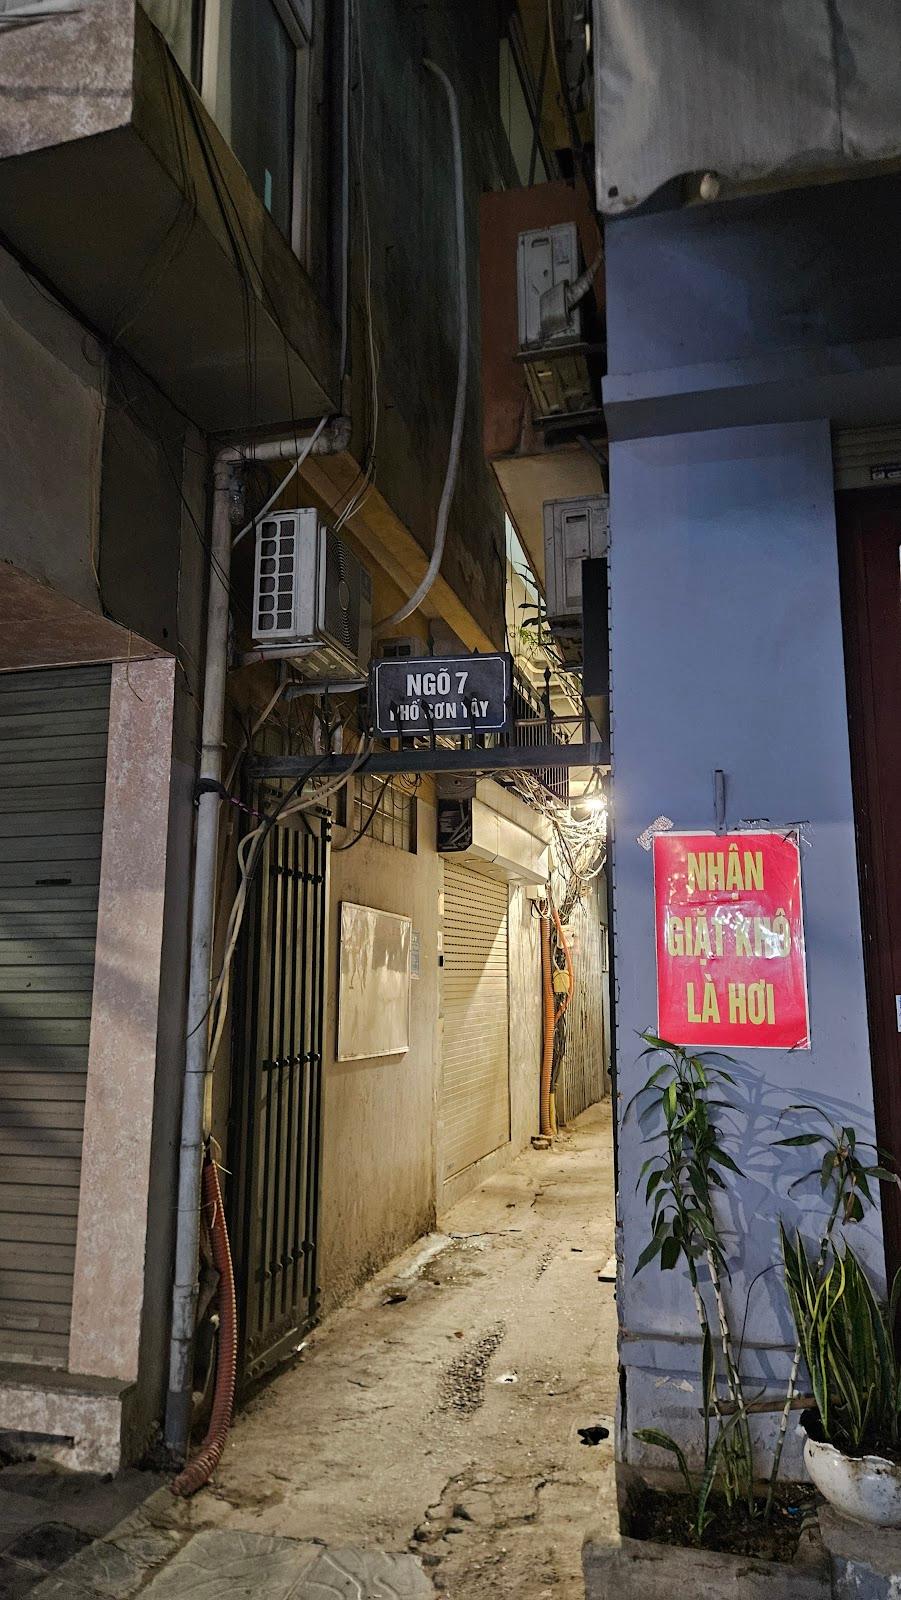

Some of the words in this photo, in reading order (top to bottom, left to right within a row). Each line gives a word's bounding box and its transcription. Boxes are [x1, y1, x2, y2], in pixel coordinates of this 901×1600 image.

[406, 667, 451, 697] NGÕ
[455, 671, 469, 694] 7
[687, 842, 765, 900] NHẬN
[667, 907, 725, 966] GIẶT
[735, 907, 791, 958] KHÔ
[686, 973, 721, 1024] LÀ
[728, 978, 776, 1025] HƠI
